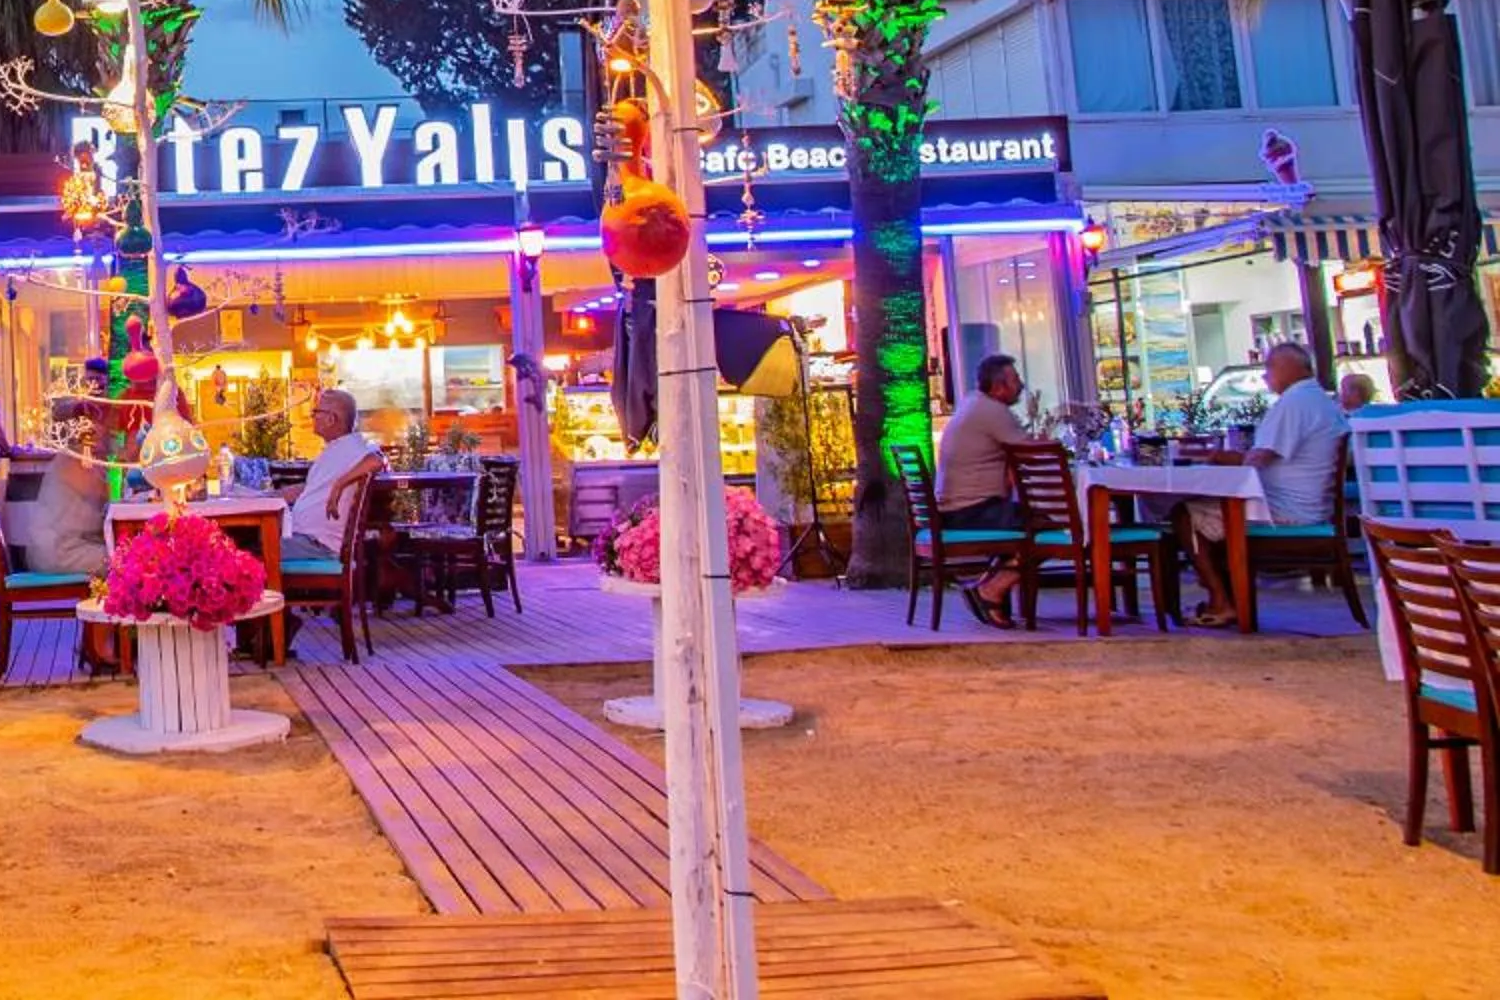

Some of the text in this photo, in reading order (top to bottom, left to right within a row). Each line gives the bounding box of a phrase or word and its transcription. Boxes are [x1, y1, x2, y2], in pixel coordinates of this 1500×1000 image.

[71, 115, 319, 197] Btez
[767, 143, 847, 171] Beac
[918, 132, 1057, 164] staurant
